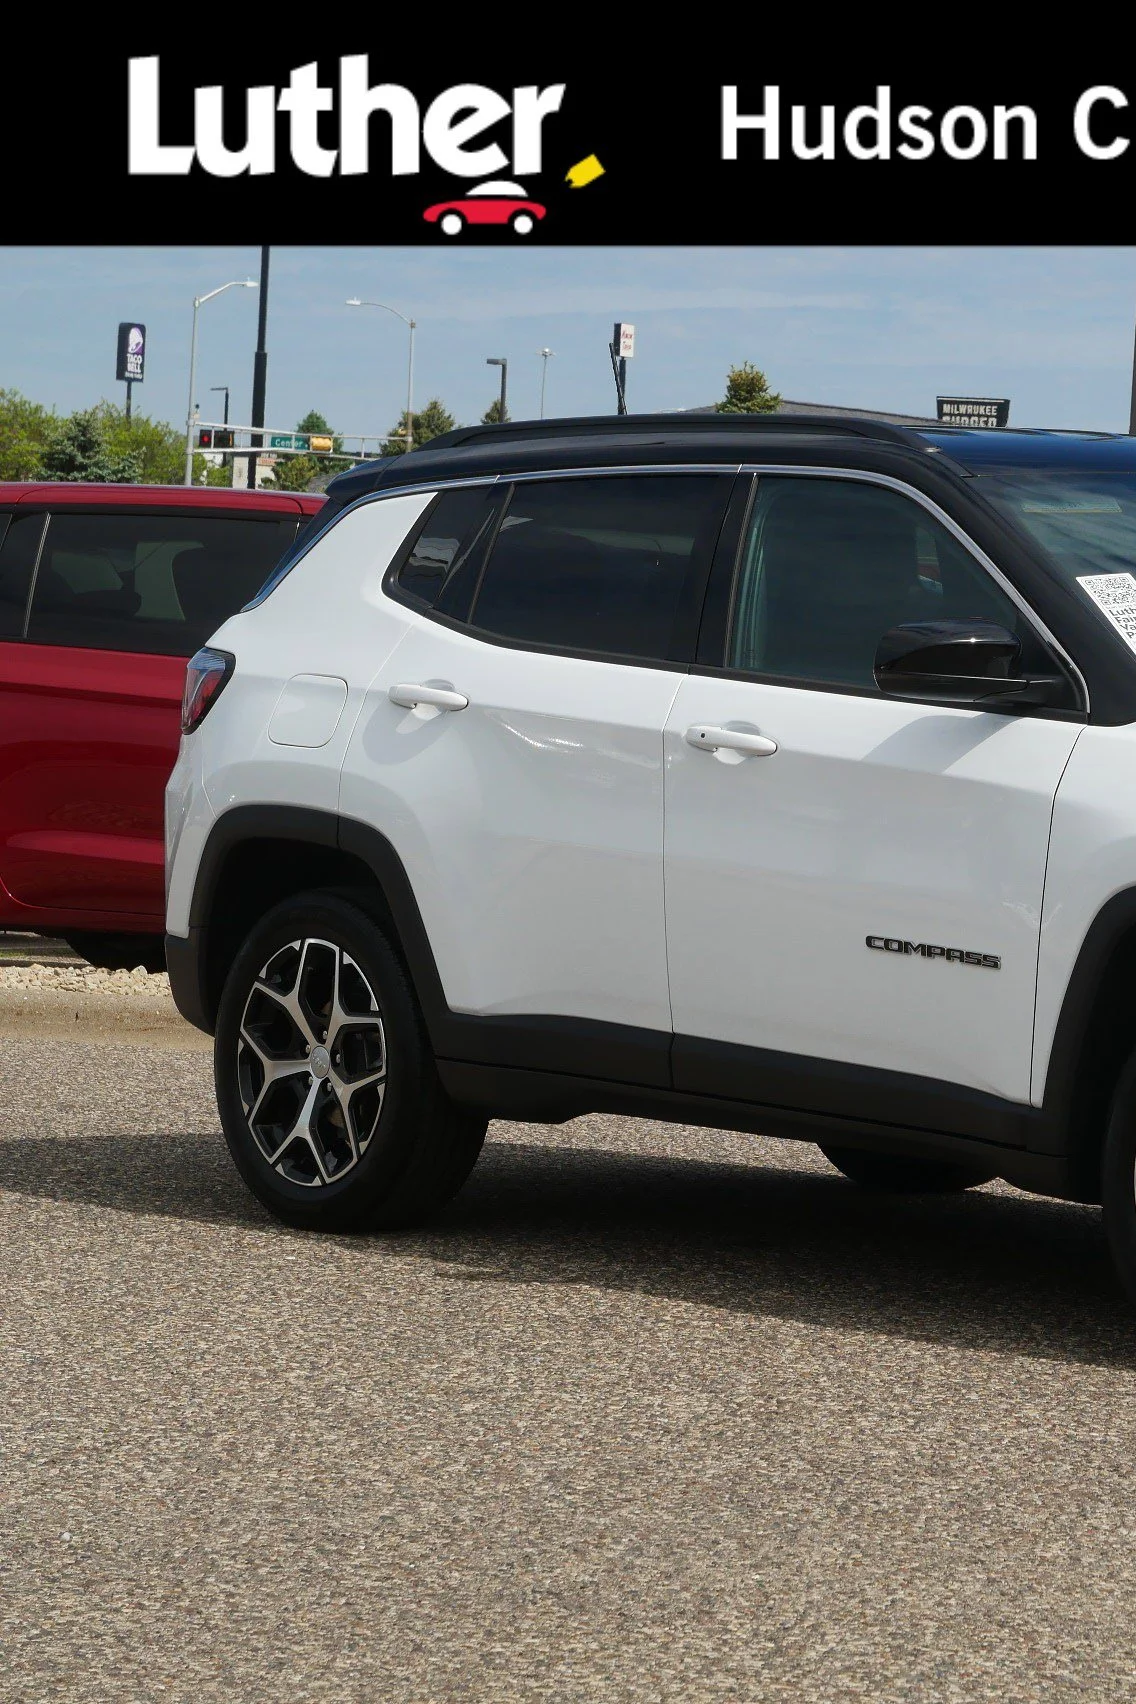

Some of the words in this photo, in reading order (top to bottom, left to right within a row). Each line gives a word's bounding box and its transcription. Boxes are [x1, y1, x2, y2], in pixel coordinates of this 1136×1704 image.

[942, 403, 998, 416] MILWAUKEE
[274, 438, 304, 448] Cener
[865, 935, 1002, 970] COMPASS
